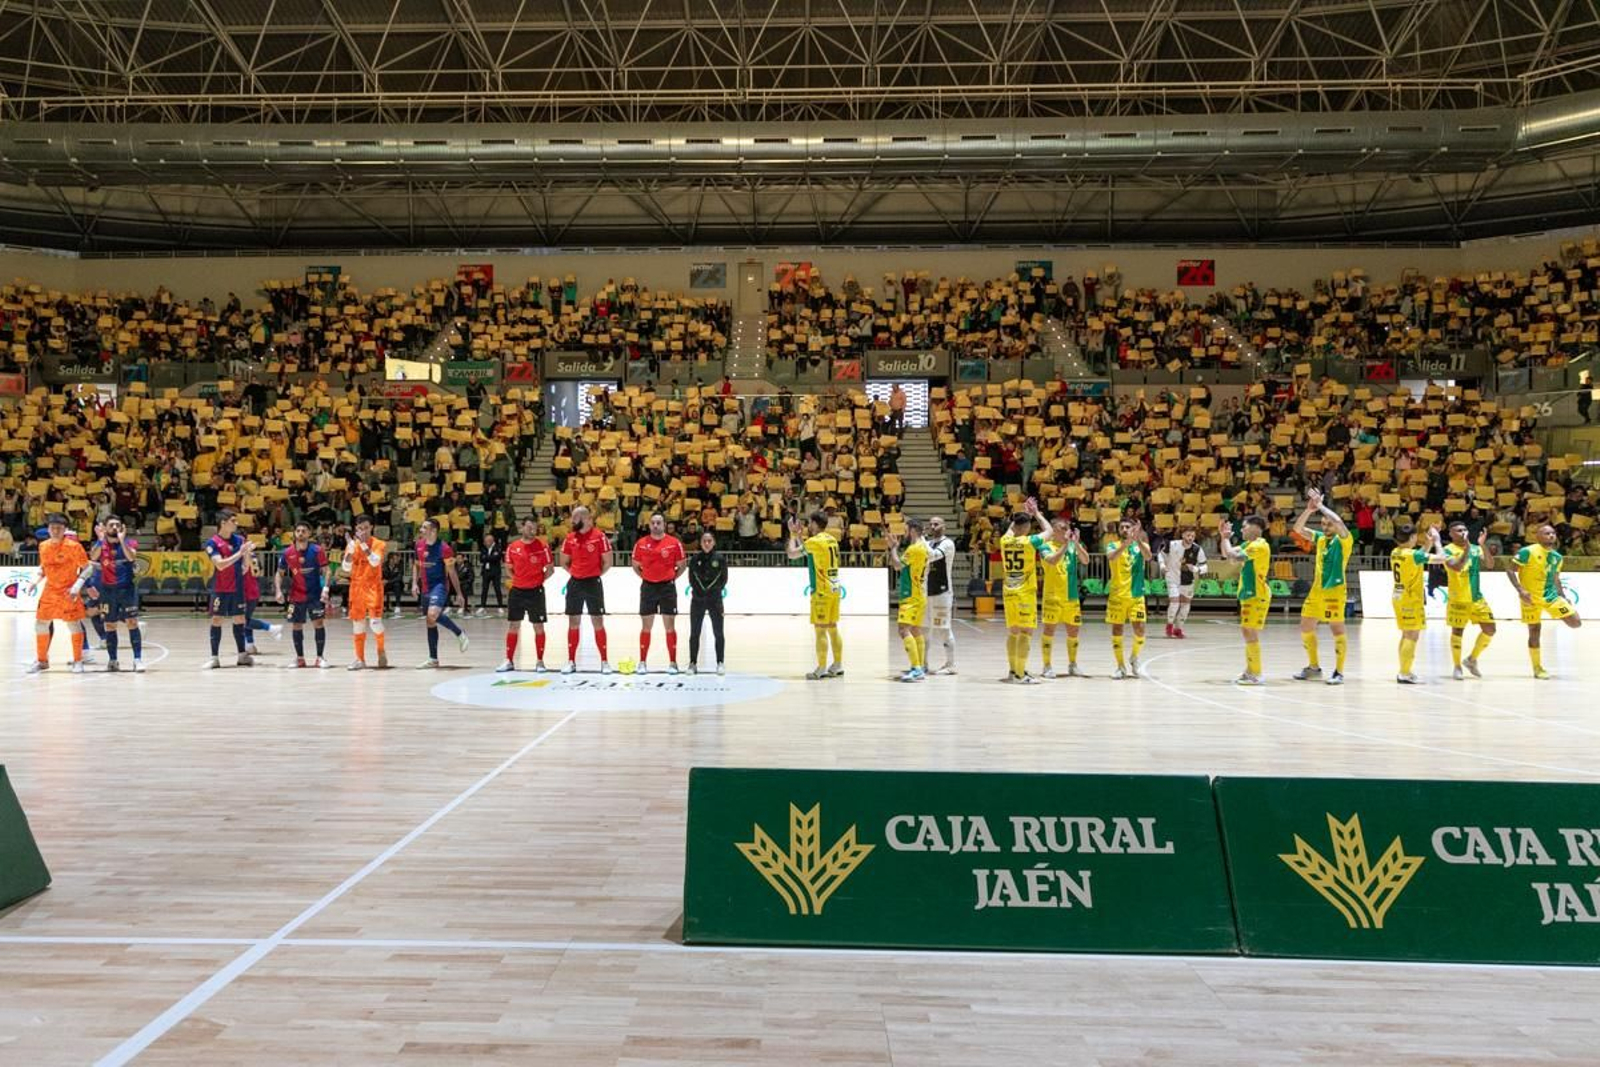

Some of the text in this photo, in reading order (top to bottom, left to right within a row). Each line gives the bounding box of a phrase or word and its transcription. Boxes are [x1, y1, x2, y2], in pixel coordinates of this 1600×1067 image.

[57, 364, 97, 375] Salida
[557, 361, 596, 373] Salida
[877, 354, 936, 372] Salida 10
[1450, 353, 1466, 371] 11
[161, 555, 201, 575] PEÑA
[1004, 550, 1024, 570] 55
[1393, 563, 1401, 583] 6
[213, 597, 221, 607] 6
[886, 816, 1174, 854] CAJA RURAL
[1432, 827, 1556, 867] CAJA
[973, 863, 1092, 910] JAÉN
